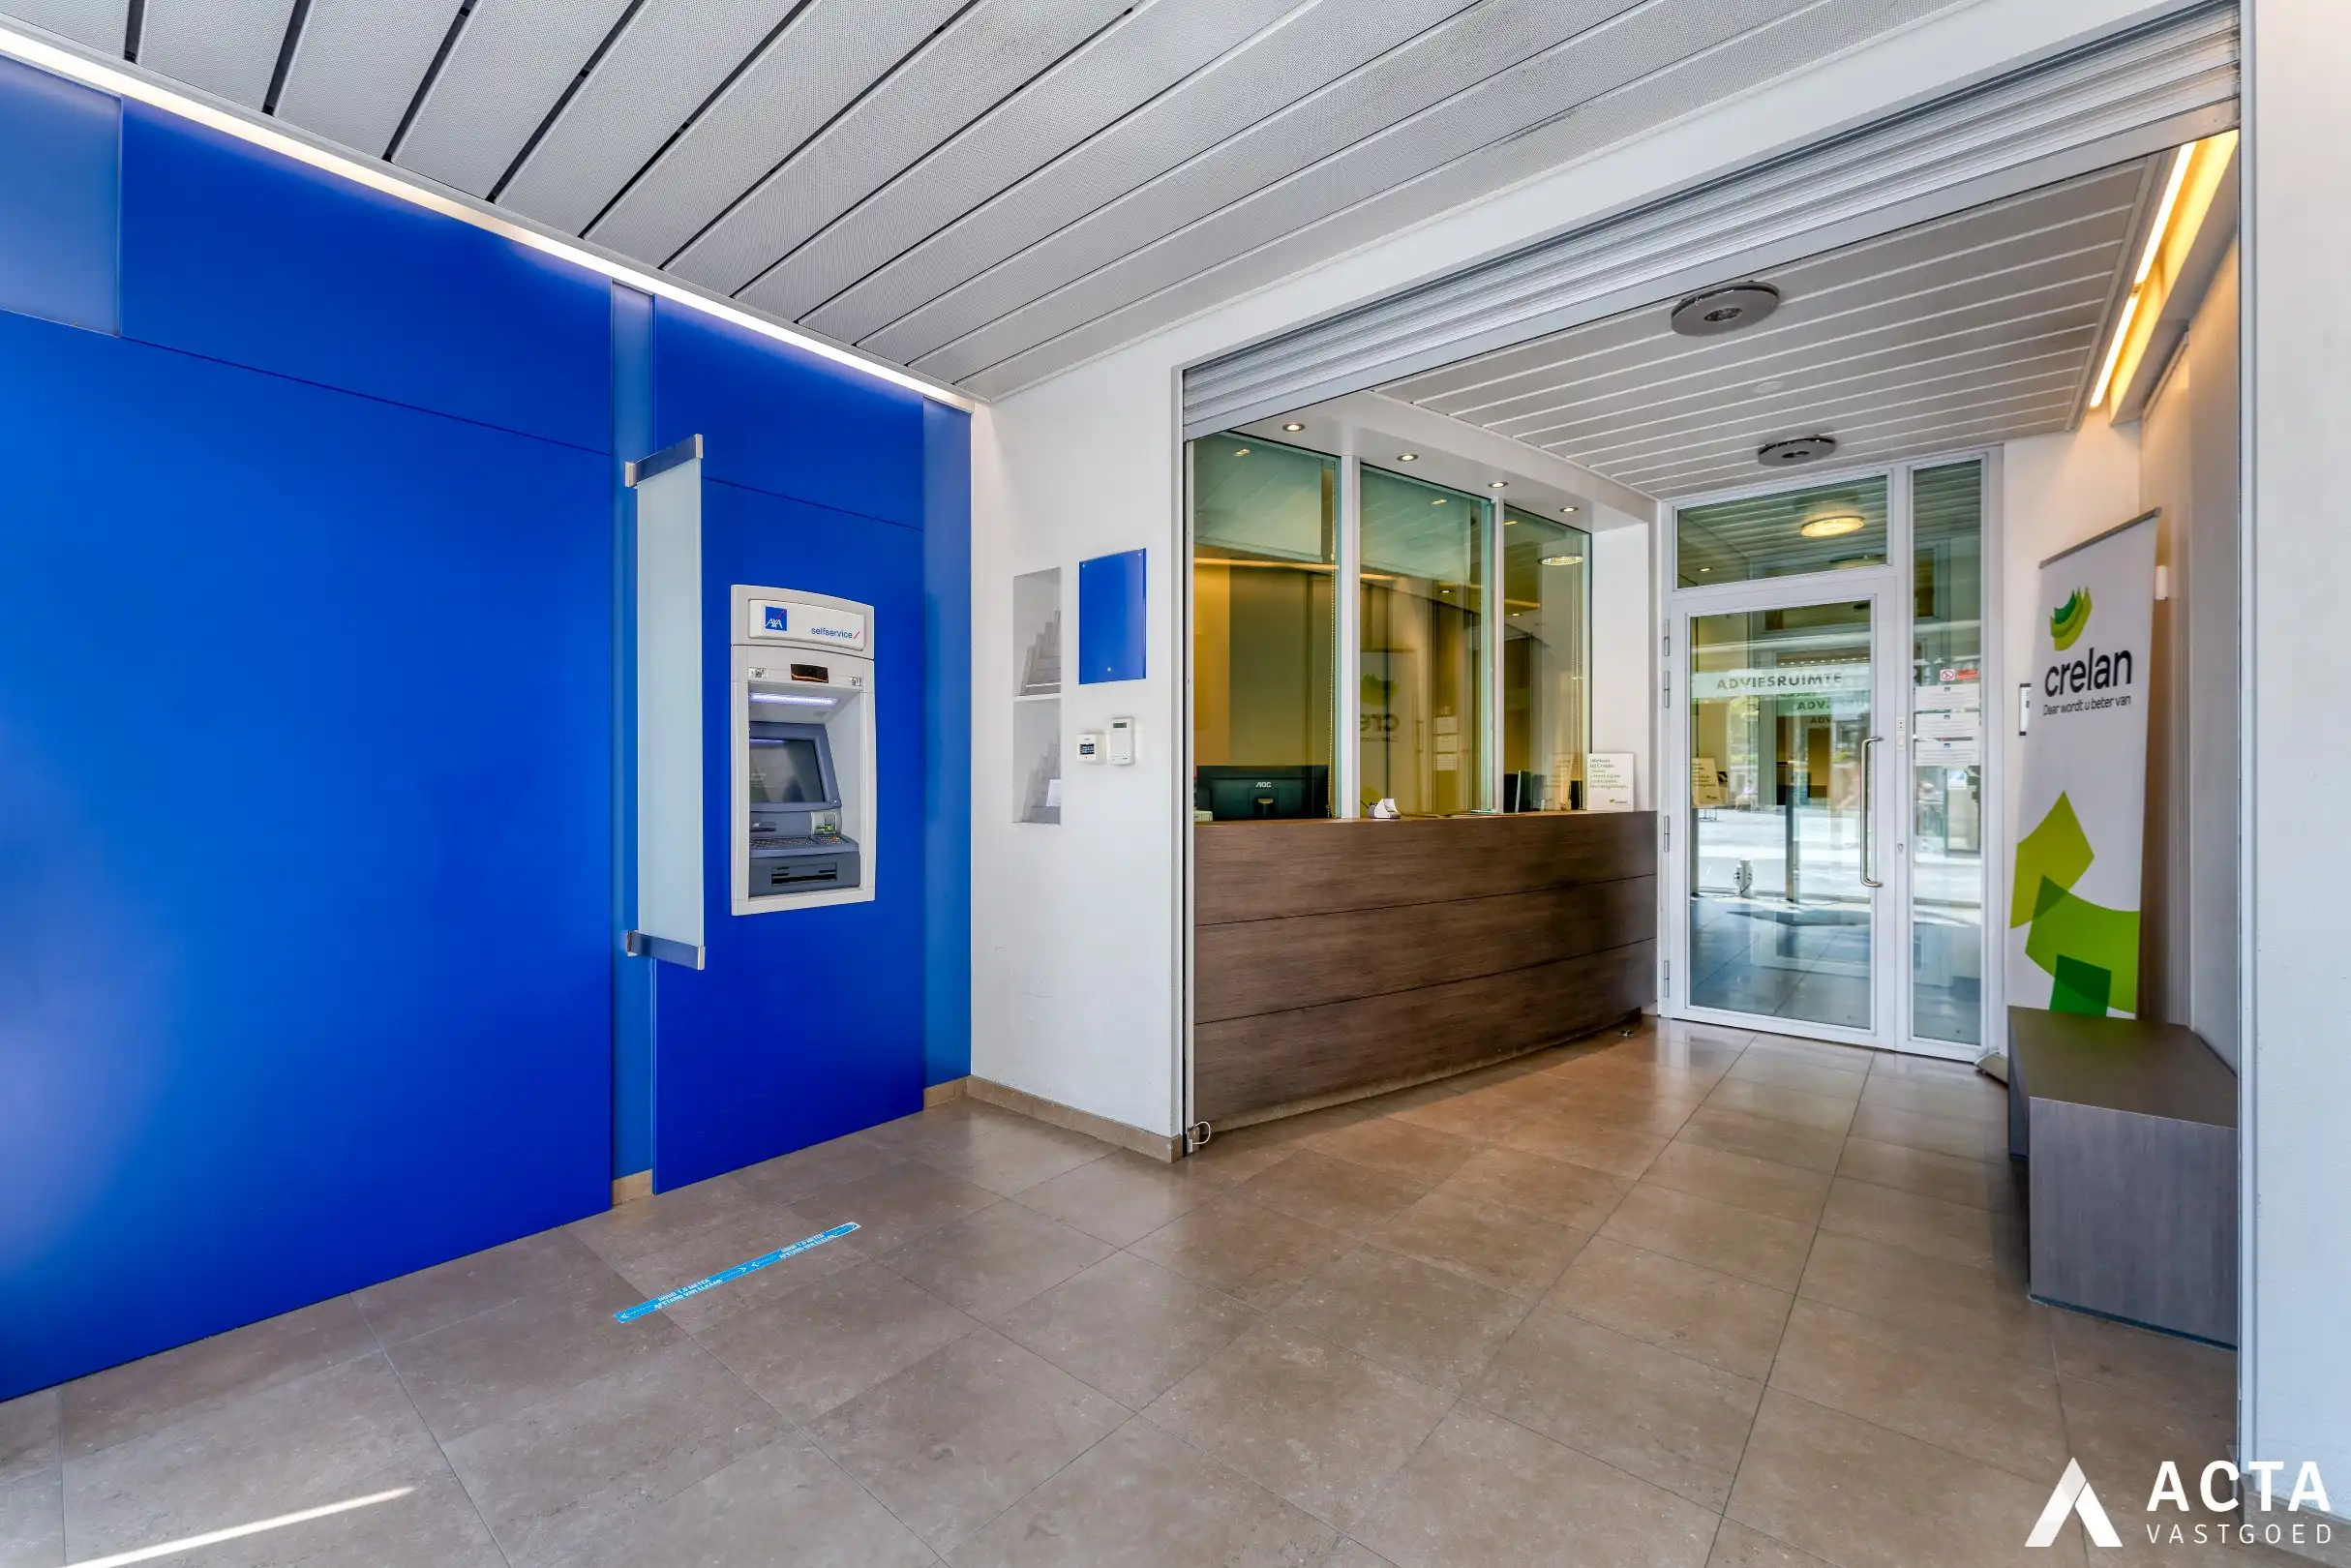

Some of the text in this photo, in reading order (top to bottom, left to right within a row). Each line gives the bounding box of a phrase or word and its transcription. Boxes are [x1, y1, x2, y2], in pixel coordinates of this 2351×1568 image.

[764, 618, 783, 628] AXA
[811, 627, 853, 639] selfservice
[2044, 647, 2132, 697] crelan
[1716, 673, 1842, 690] ADVIESRUIMTE
[2043, 695, 2131, 715] Daar wordt u beter van
